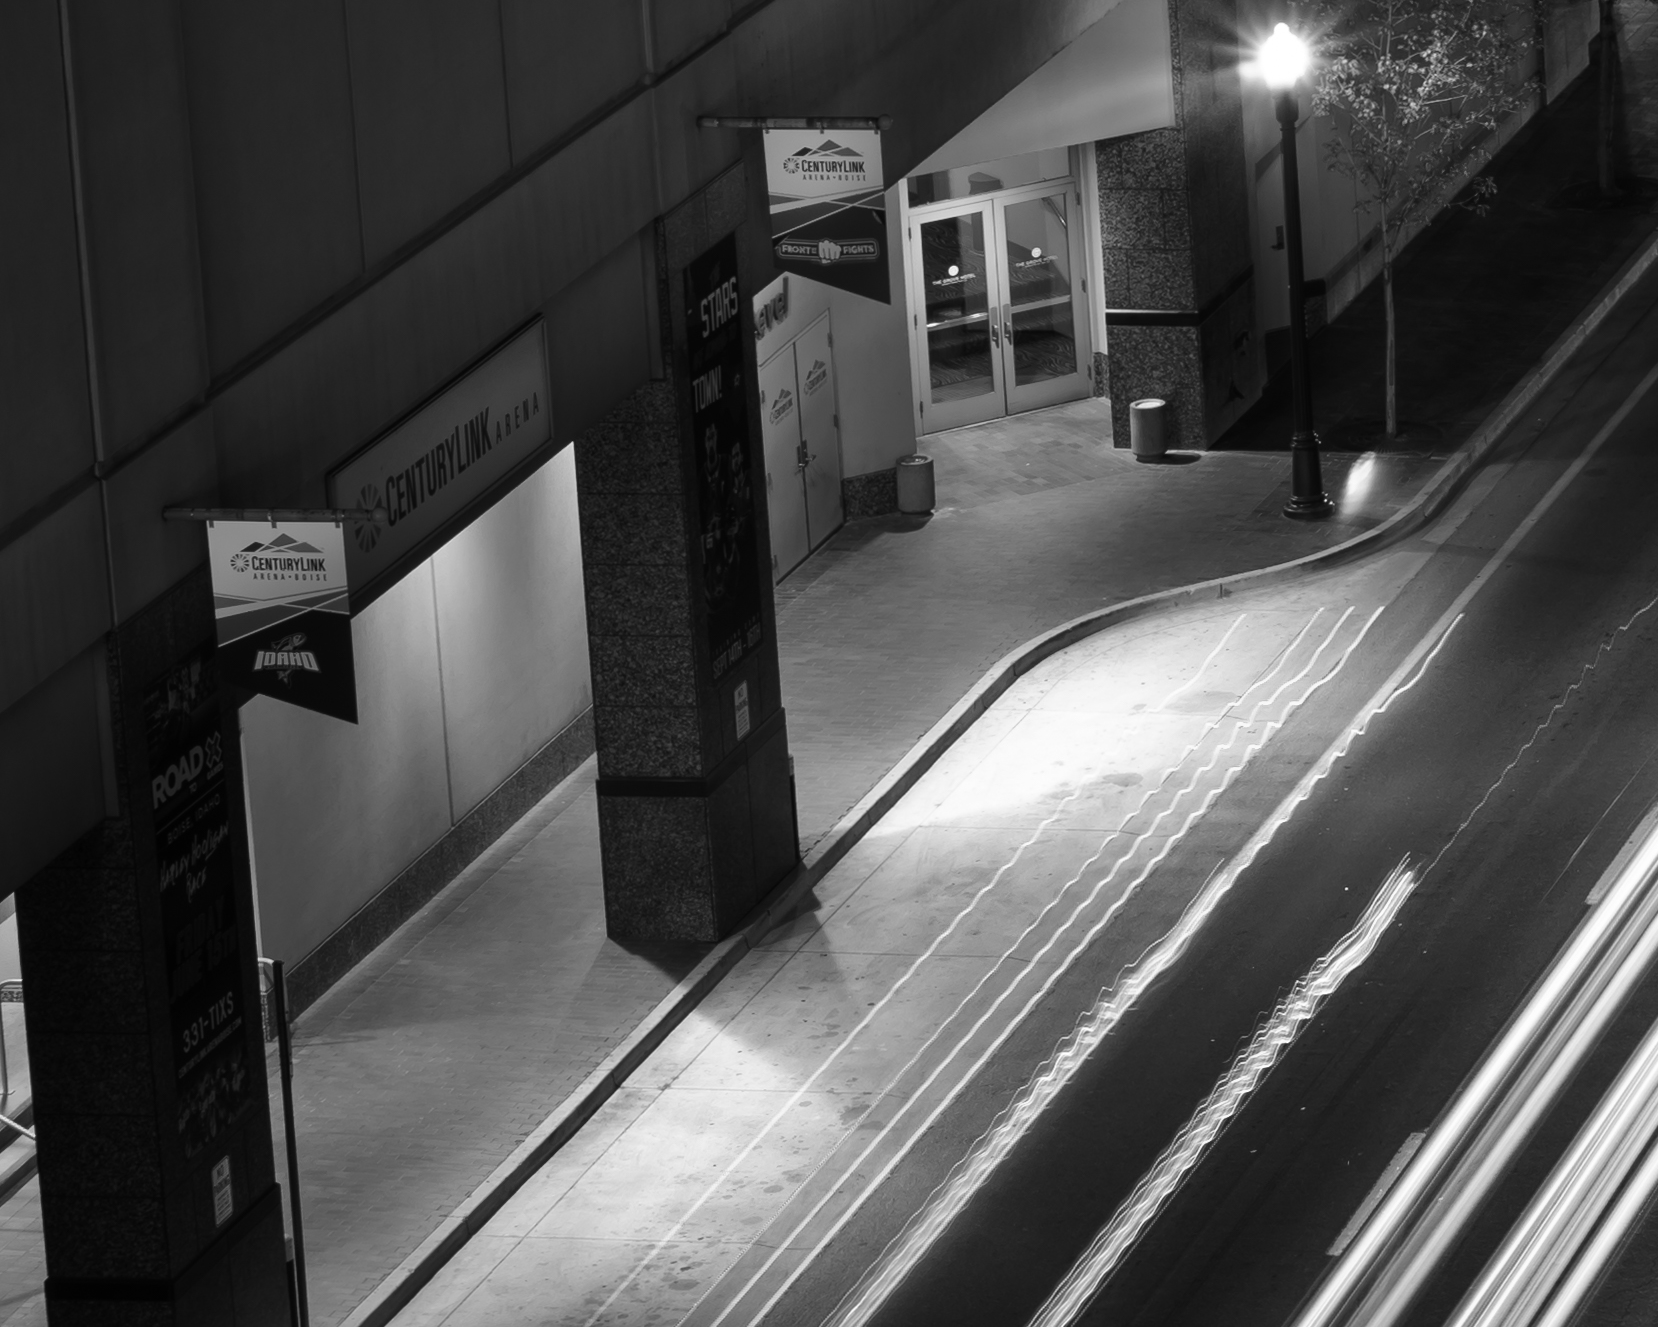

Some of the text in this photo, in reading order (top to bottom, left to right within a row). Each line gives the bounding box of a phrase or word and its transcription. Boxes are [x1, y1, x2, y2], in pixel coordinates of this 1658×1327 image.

[801, 159, 866, 174] CENTURYLINK
[843, 244, 875, 254] FIGHTS
[701, 275, 739, 338] STARS
[692, 365, 723, 414] TOWN!
[385, 391, 540, 527] CENTURYLINK ARENA
[251, 556, 326, 572] CENTURYLINK
[252, 573, 328, 581] ARENA BOISE
[253, 650, 322, 673] IDAHO
[152, 745, 204, 811] ROAD
[194, 793, 221, 822] IDAHO
[182, 991, 235, 1054] 331-TIXS
